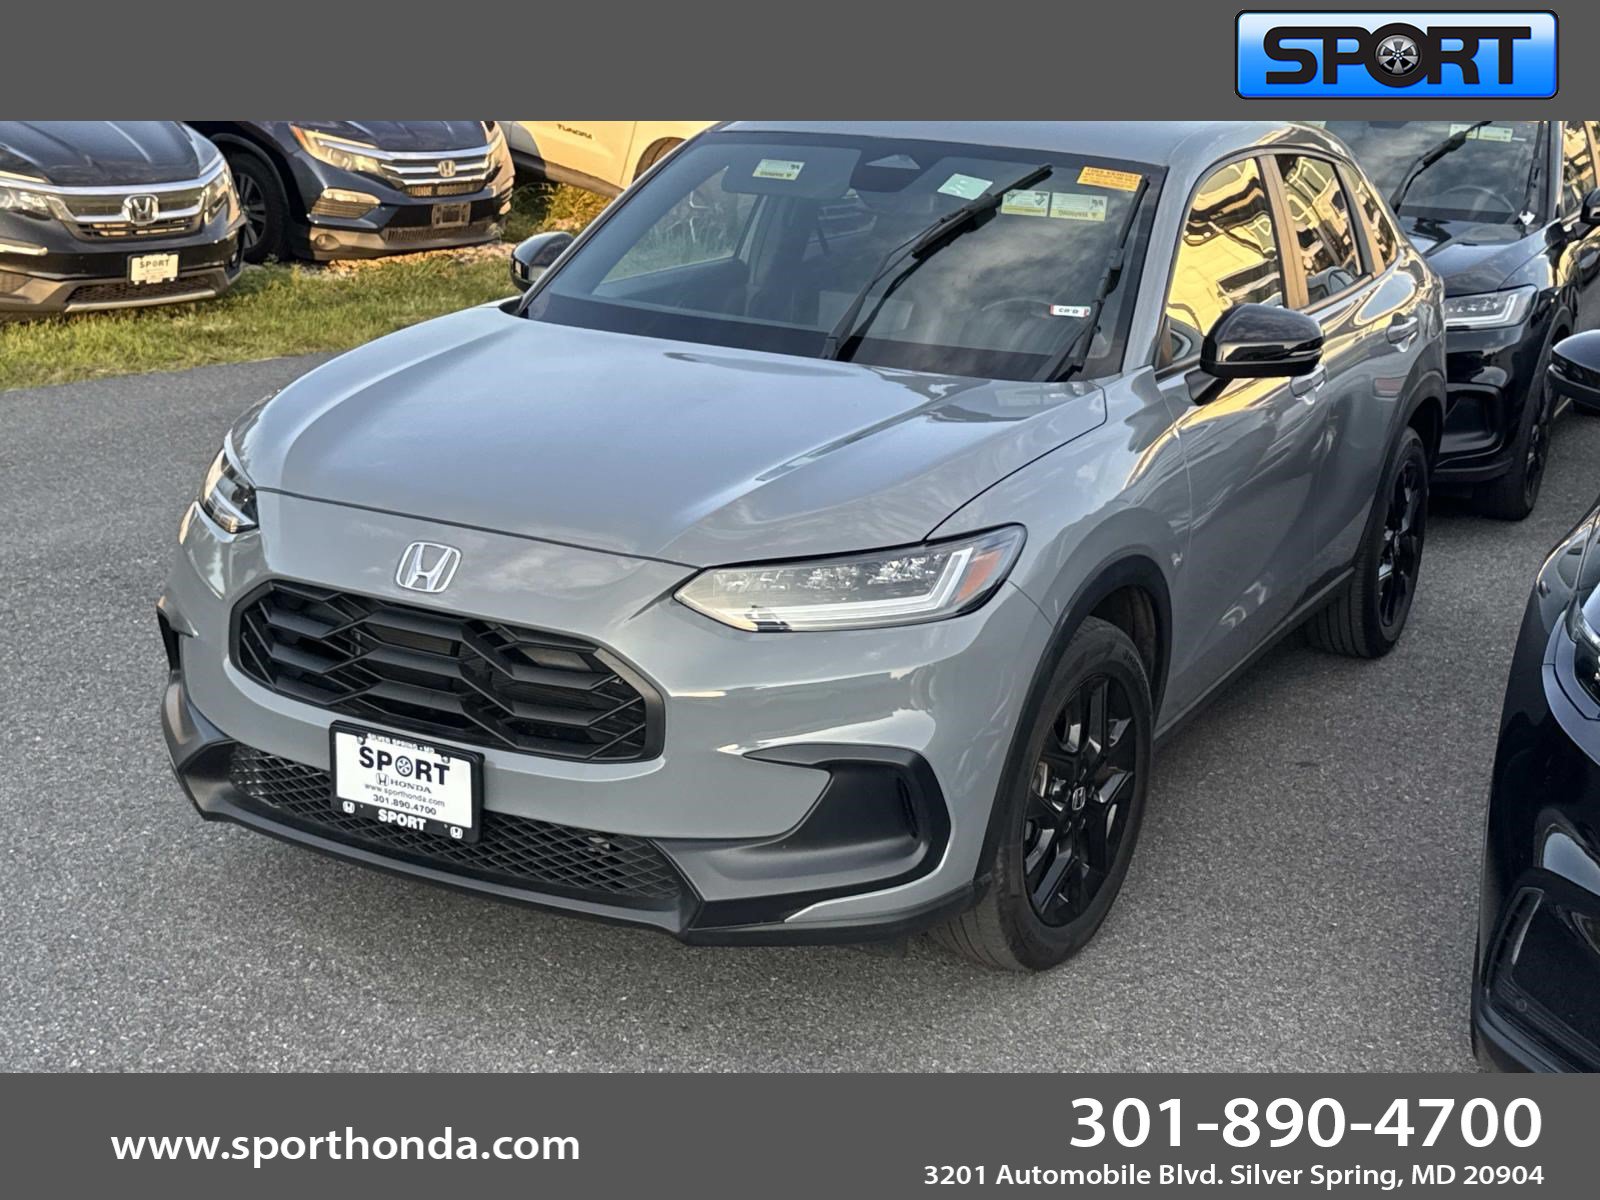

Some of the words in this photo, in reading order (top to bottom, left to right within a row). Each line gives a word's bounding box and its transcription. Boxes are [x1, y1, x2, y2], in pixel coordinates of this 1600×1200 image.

[359, 746, 451, 785] SPORT
[364, 783, 446, 807] www.sporthonda.com
[390, 779, 432, 794] HONDA
[373, 794, 437, 816] 301.890.4700
[378, 809, 427, 831] SPORT
